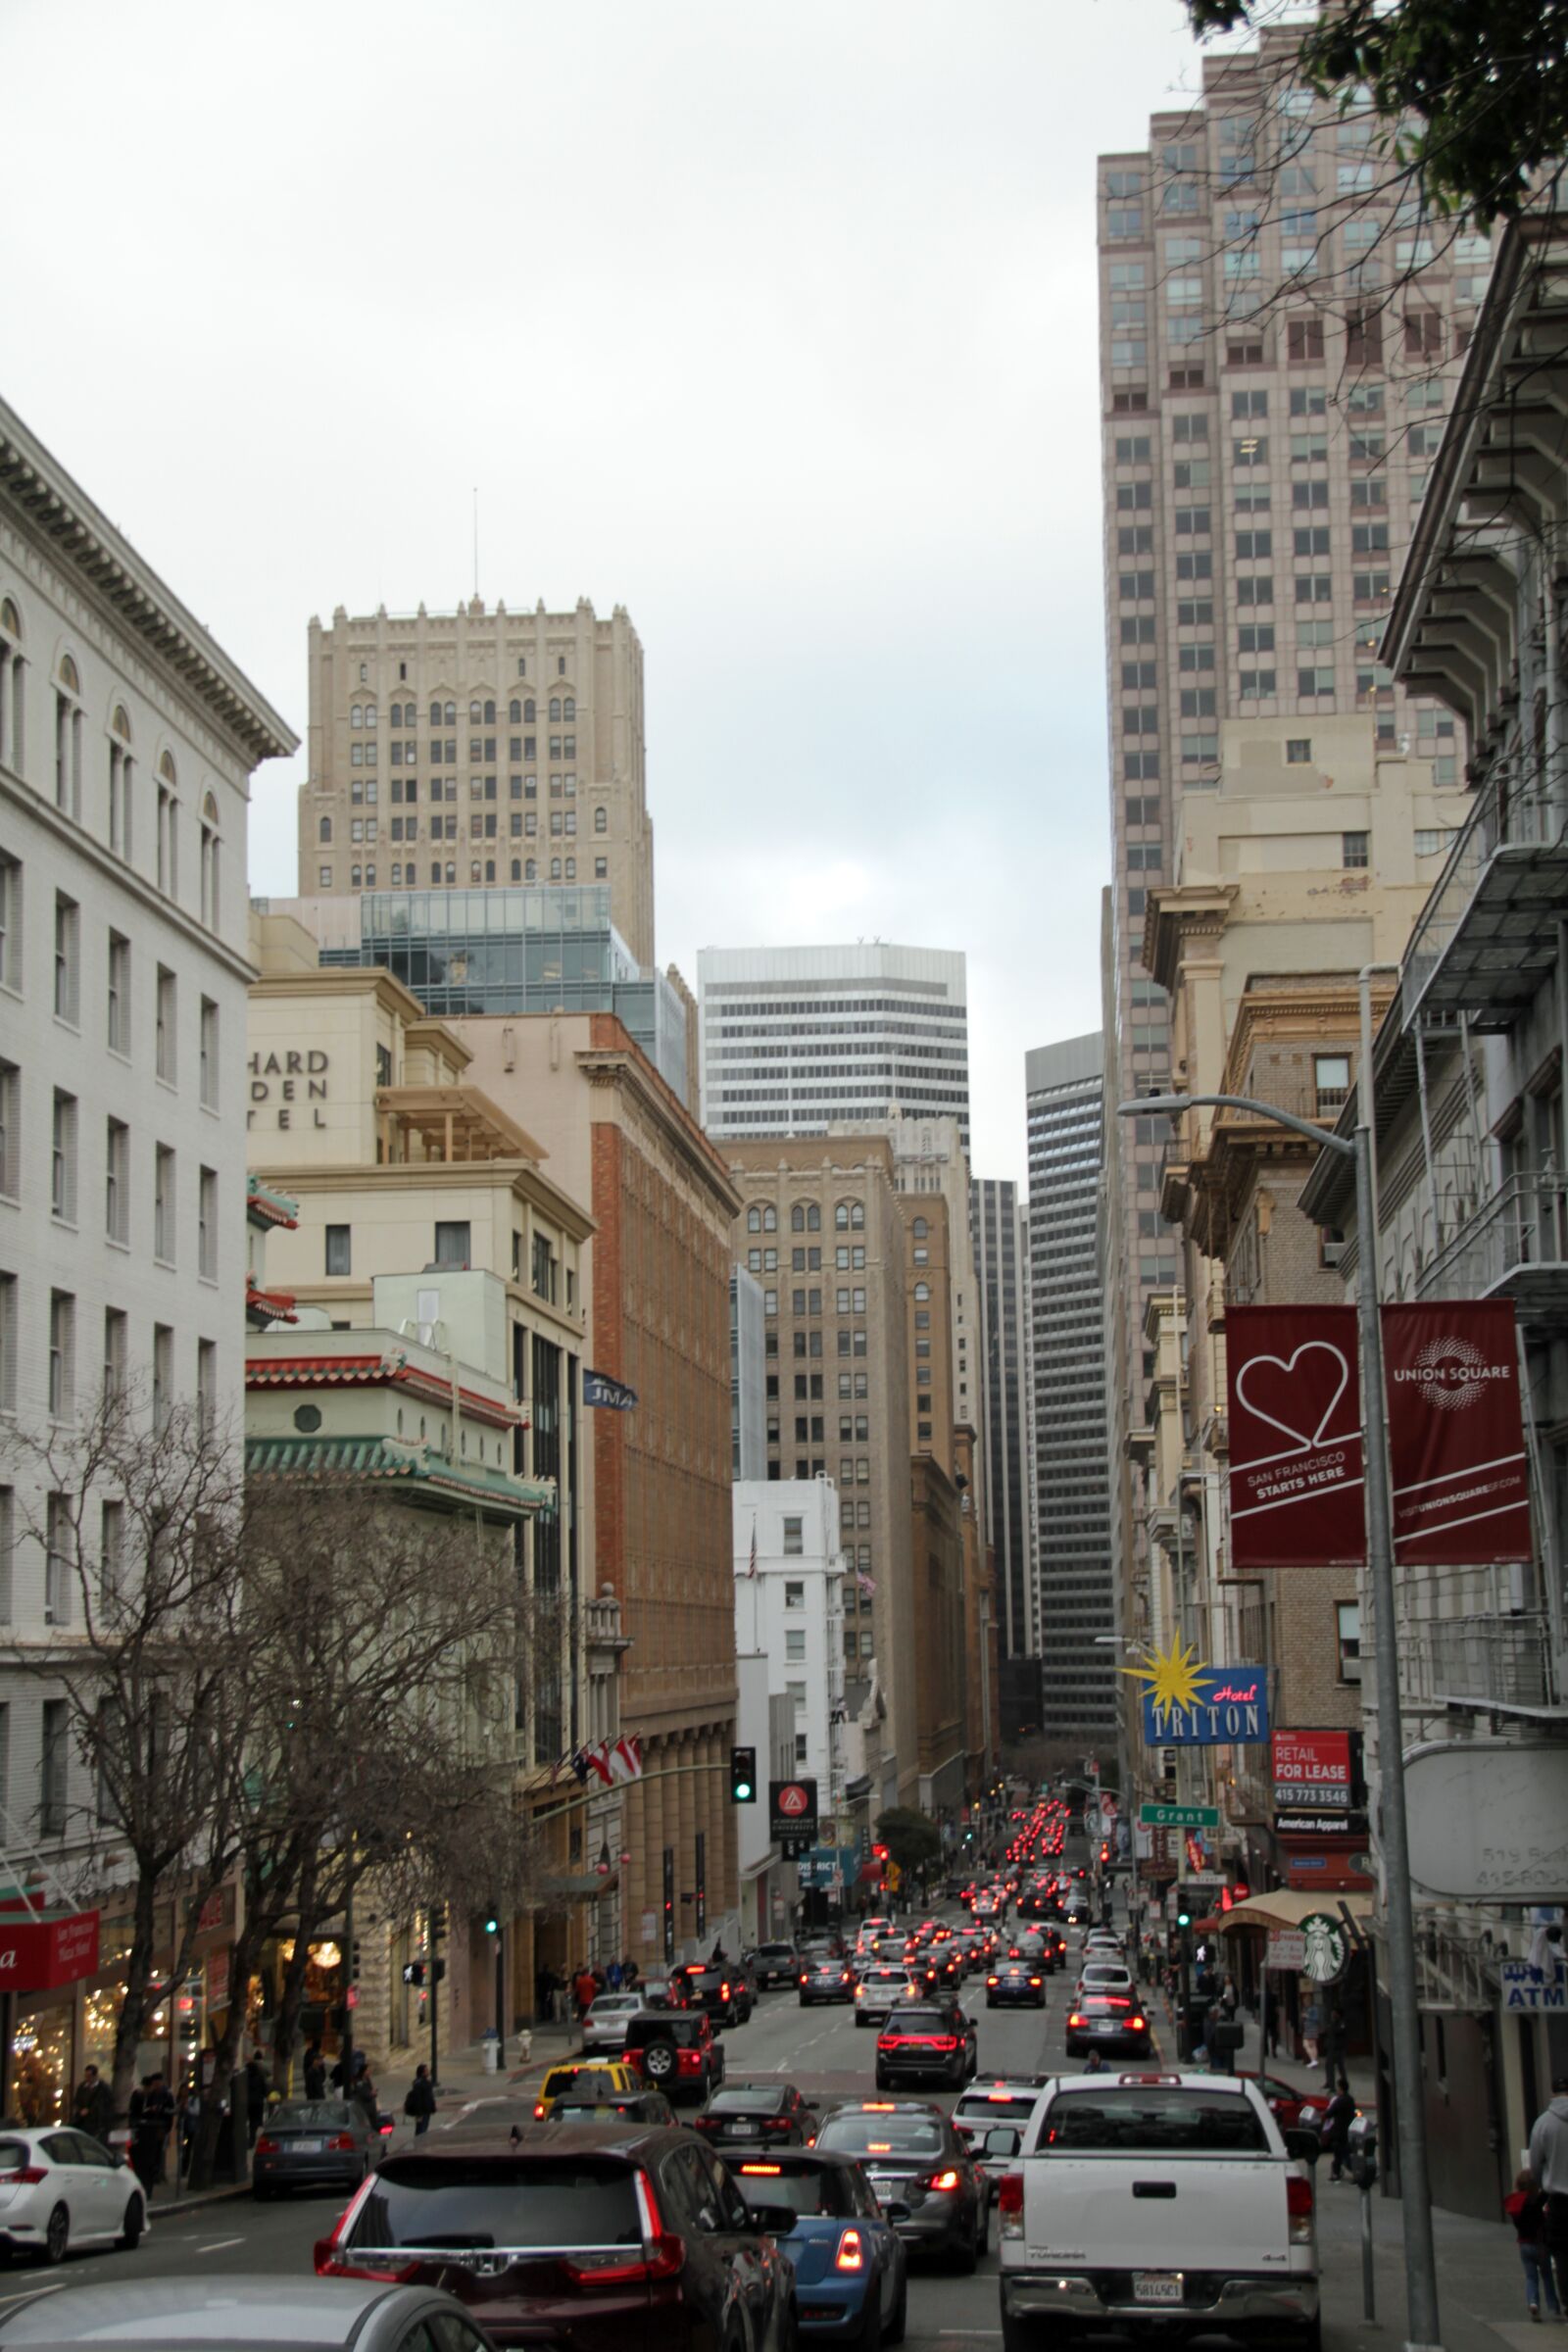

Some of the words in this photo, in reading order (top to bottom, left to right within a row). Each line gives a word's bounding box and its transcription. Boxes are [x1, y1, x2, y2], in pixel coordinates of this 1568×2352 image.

[1394, 1368, 1446, 1382] UNION
[1448, 1365, 1510, 1381] SQUARE
[592, 1387, 633, 1406] JMA
[1247, 1471, 1272, 1488] SAN
[1275, 1450, 1346, 1480] FRANCISCO
[1256, 1477, 1305, 1499] STARTS
[1307, 1465, 1346, 1485] HERE
[1212, 1684, 1257, 1702] Hotel
[1152, 1704, 1259, 1739] TRITON
[1275, 1746, 1318, 1762] RETAIL
[1276, 1764, 1302, 1779] FOR
[1305, 1765, 1347, 1780] LEASE
[1275, 1788, 1294, 1801] 415
[1297, 1789, 1316, 1802] 773
[1319, 1789, 1348, 1803] 3546
[1156, 1809, 1204, 1823] Grant
[1277, 1817, 1315, 1830] American
[1316, 1818, 1348, 1831] Apparel
[799, 1861, 837, 1871] DISRICT
[1507, 1986, 1565, 2007] ATM
